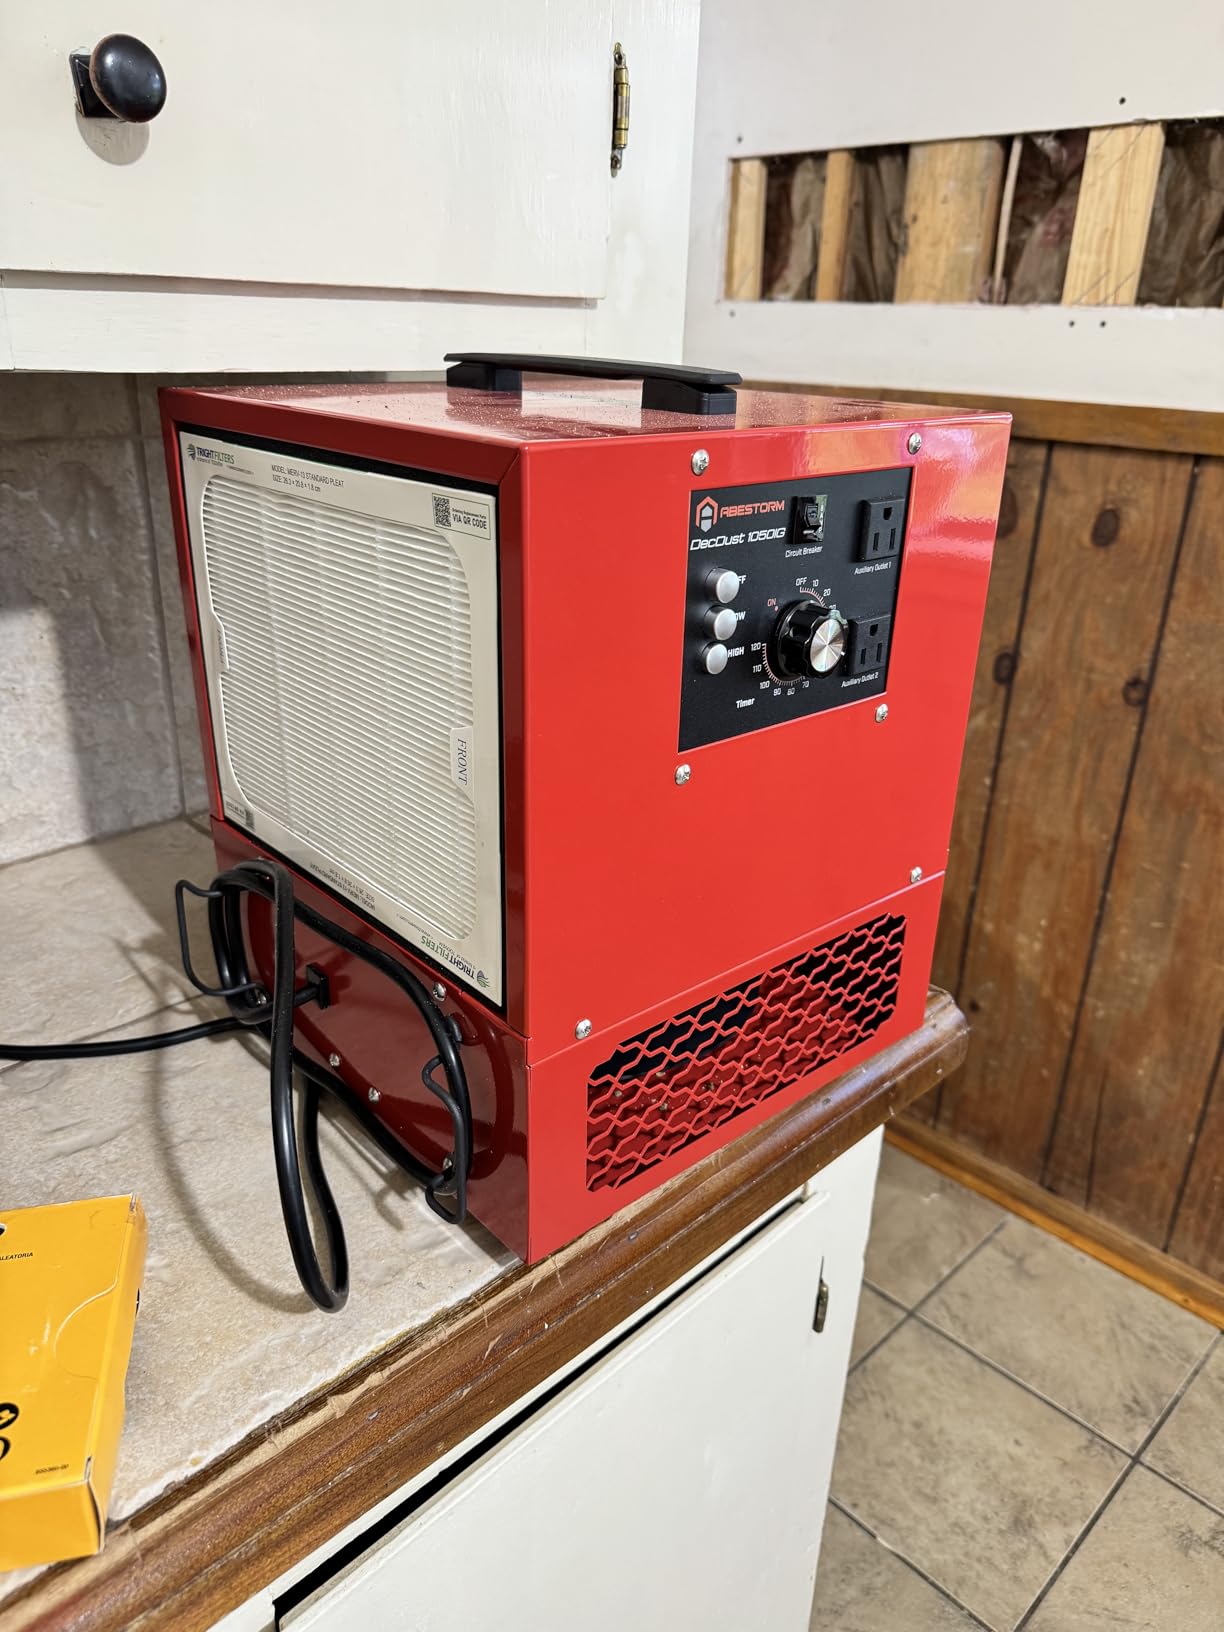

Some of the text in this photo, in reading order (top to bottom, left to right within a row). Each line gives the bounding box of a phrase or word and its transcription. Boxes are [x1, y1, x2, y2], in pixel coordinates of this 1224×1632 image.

[305, 472, 330, 485] STANDARD
[329, 477, 345, 487] PLEAT
[720, 500, 785, 519] ABESTORM
[453, 514, 487, 529] VIA QR CODE
[690, 534, 746, 550] DecDust
[785, 546, 823, 558] Circuit Breaker
[854, 566, 874, 575] Auxiliary
[875, 563, 889, 571] Outlet
[795, 577, 808, 587] OFF
[812, 579, 819, 587] 10
[823, 588, 831, 597] 20
[767, 598, 777, 607] ON
[727, 646, 745, 658] HIGH
[750, 642, 762, 652] 120
[752, 664, 762, 673] 110
[759, 680, 770, 690] 100
[802, 680, 810, 689] 70
[841, 678, 861, 688] Auxiliary
[862, 674, 874, 682] Outlet
[773, 687, 781, 696] 90
[736, 698, 755, 708] Timer
[457, 738, 468, 786] FRONT
[421, 935, 475, 979] TRIGHTFILTERS
